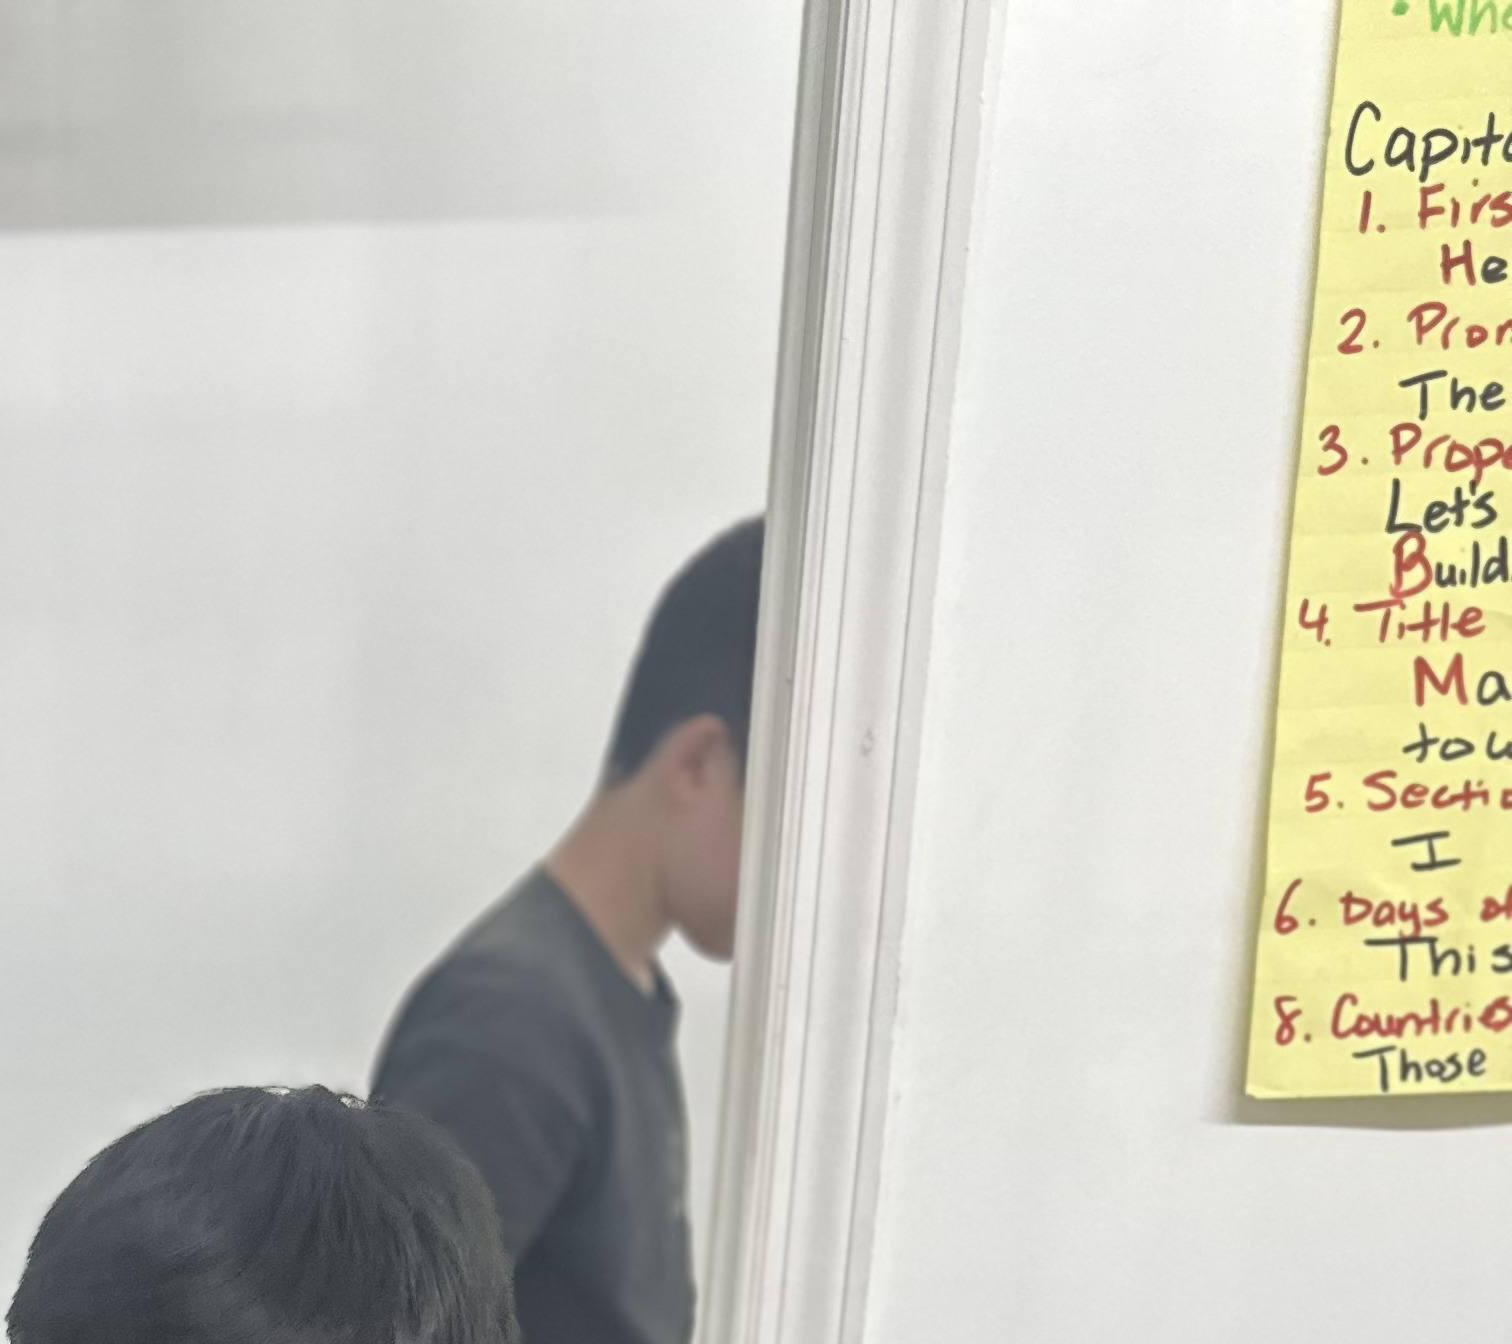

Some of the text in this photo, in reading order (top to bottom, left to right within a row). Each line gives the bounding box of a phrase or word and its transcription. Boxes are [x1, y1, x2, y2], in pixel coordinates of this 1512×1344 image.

[1358, 189, 1386, 234] 1.
[1440, 239, 1508, 286] He
[1337, 307, 1380, 354] 2.
[1398, 369, 1506, 420] The
[1317, 424, 1369, 476] 3.
[1298, 598, 1486, 647] 4. Title
[1304, 771, 1345, 813] 5.
[1390, 830, 1462, 872] I
[1274, 878, 1316, 935] 6.
[1338, 890, 1450, 938] Days
[1273, 994, 1312, 1046] 8.
[1352, 1045, 1487, 1093] Those
